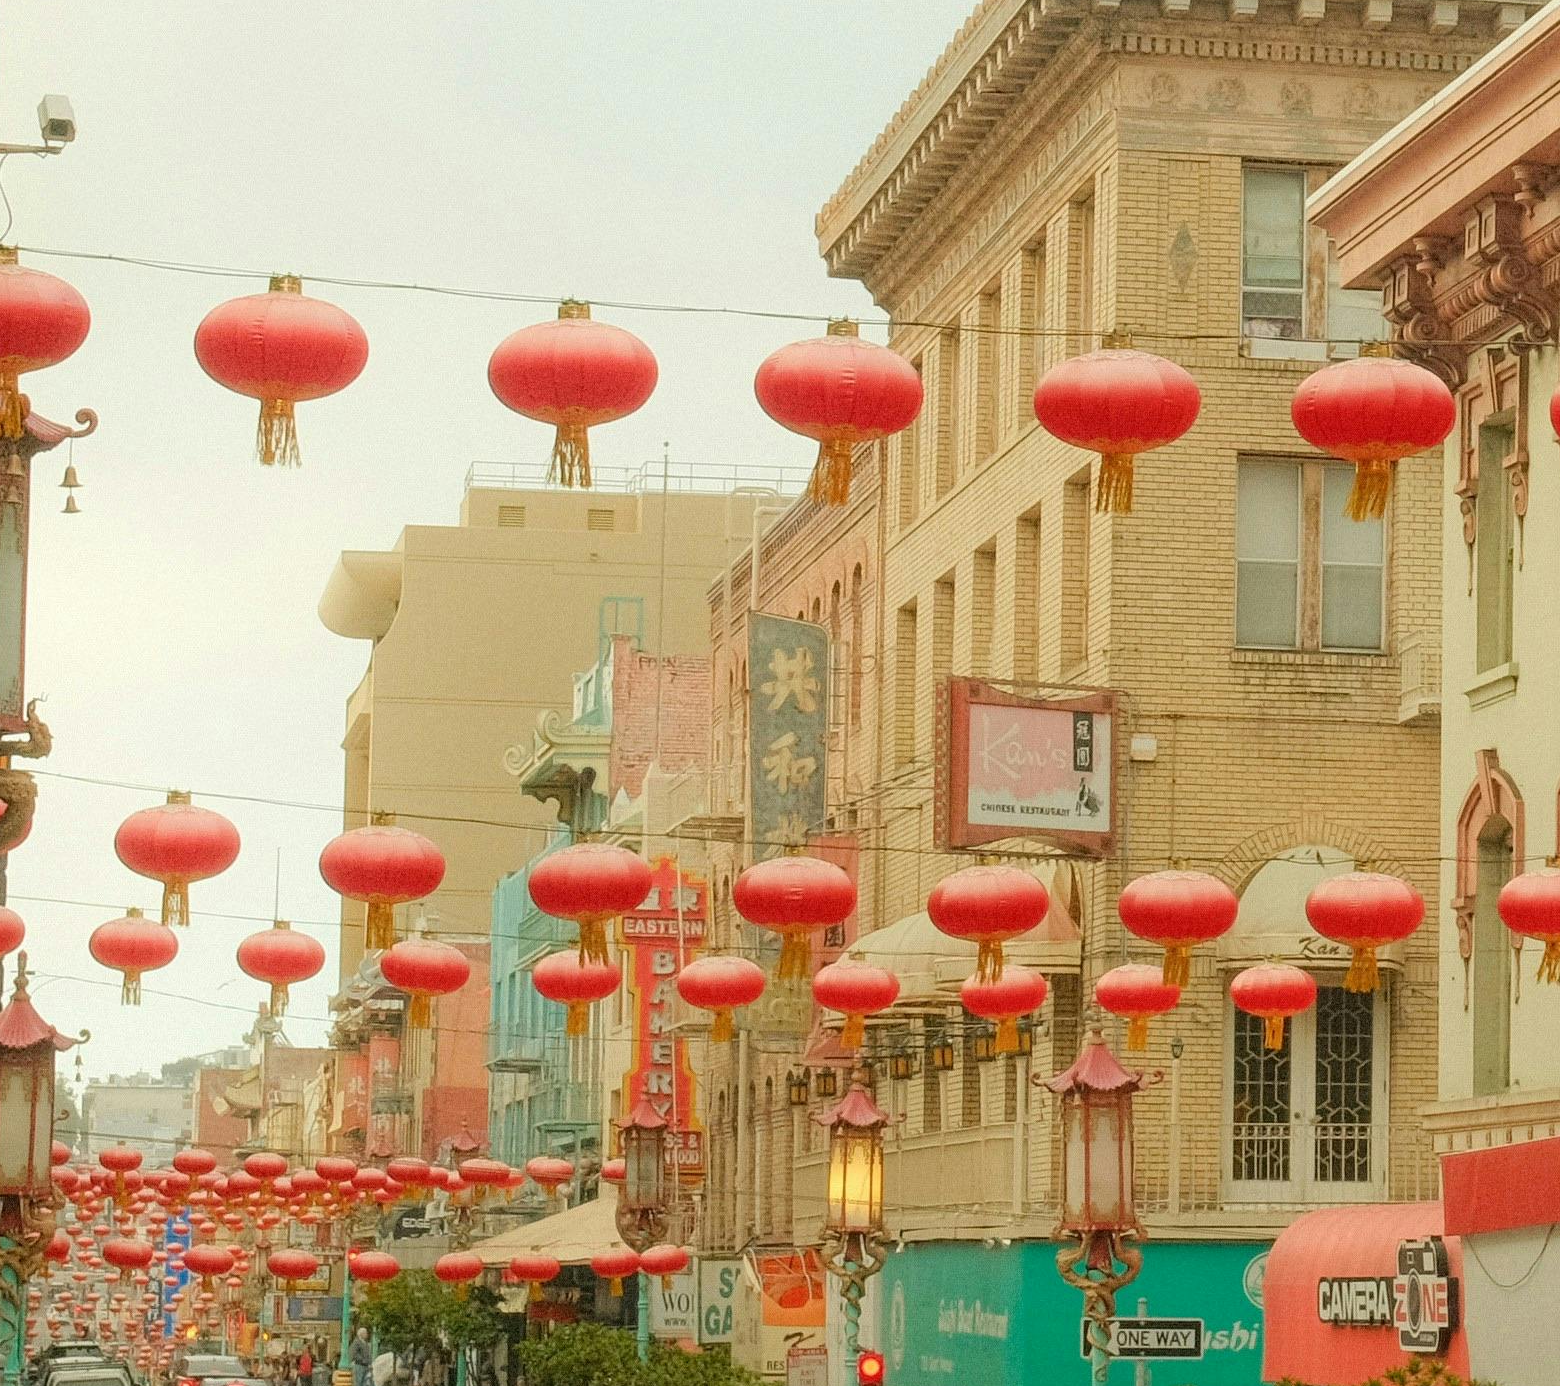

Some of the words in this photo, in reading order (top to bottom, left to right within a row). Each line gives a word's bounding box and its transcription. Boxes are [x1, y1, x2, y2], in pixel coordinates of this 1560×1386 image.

[623, 918, 703, 936] EASTERN
[1317, 1278, 1392, 1323] CAMERA
[1116, 1330, 1151, 1347] ONE
[1154, 1330, 1192, 1347] WAY
